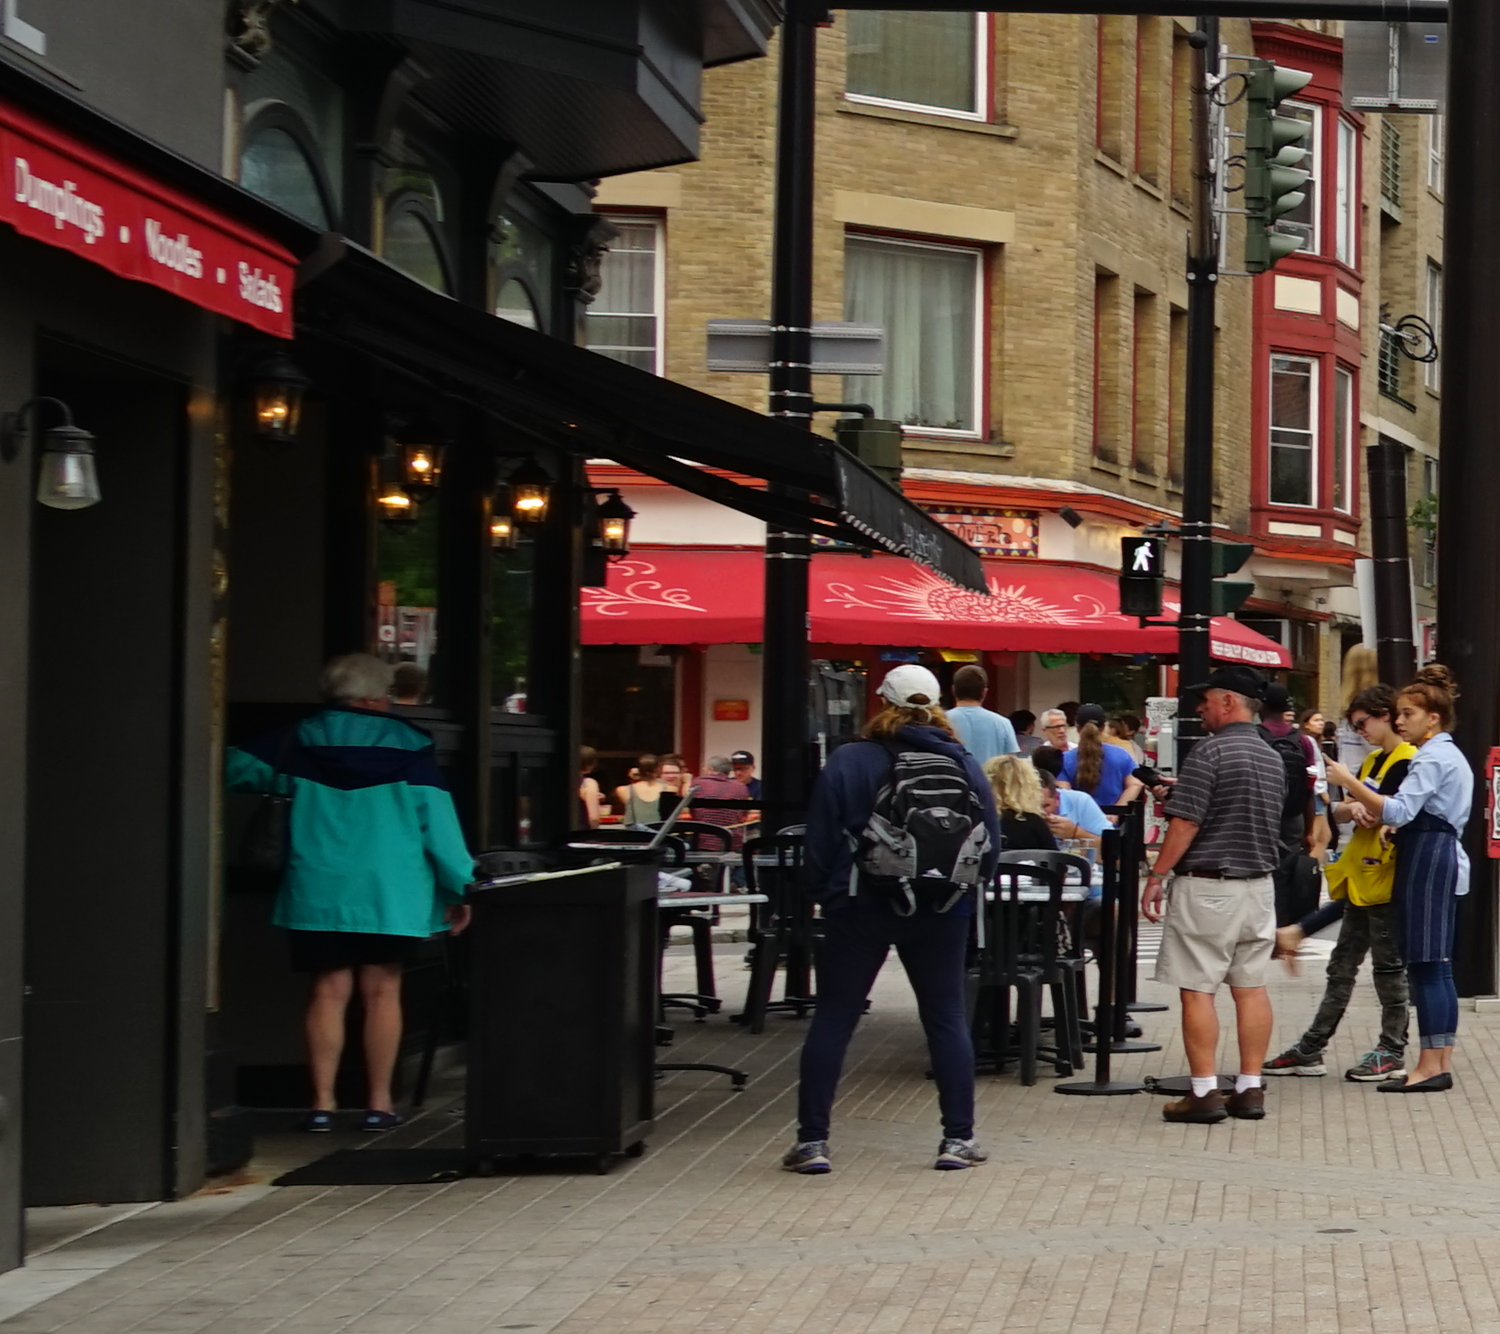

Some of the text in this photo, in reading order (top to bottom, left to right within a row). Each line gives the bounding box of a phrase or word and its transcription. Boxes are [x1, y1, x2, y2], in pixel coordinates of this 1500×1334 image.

[14, 156, 283, 313] Dumplings Noodles Salads
